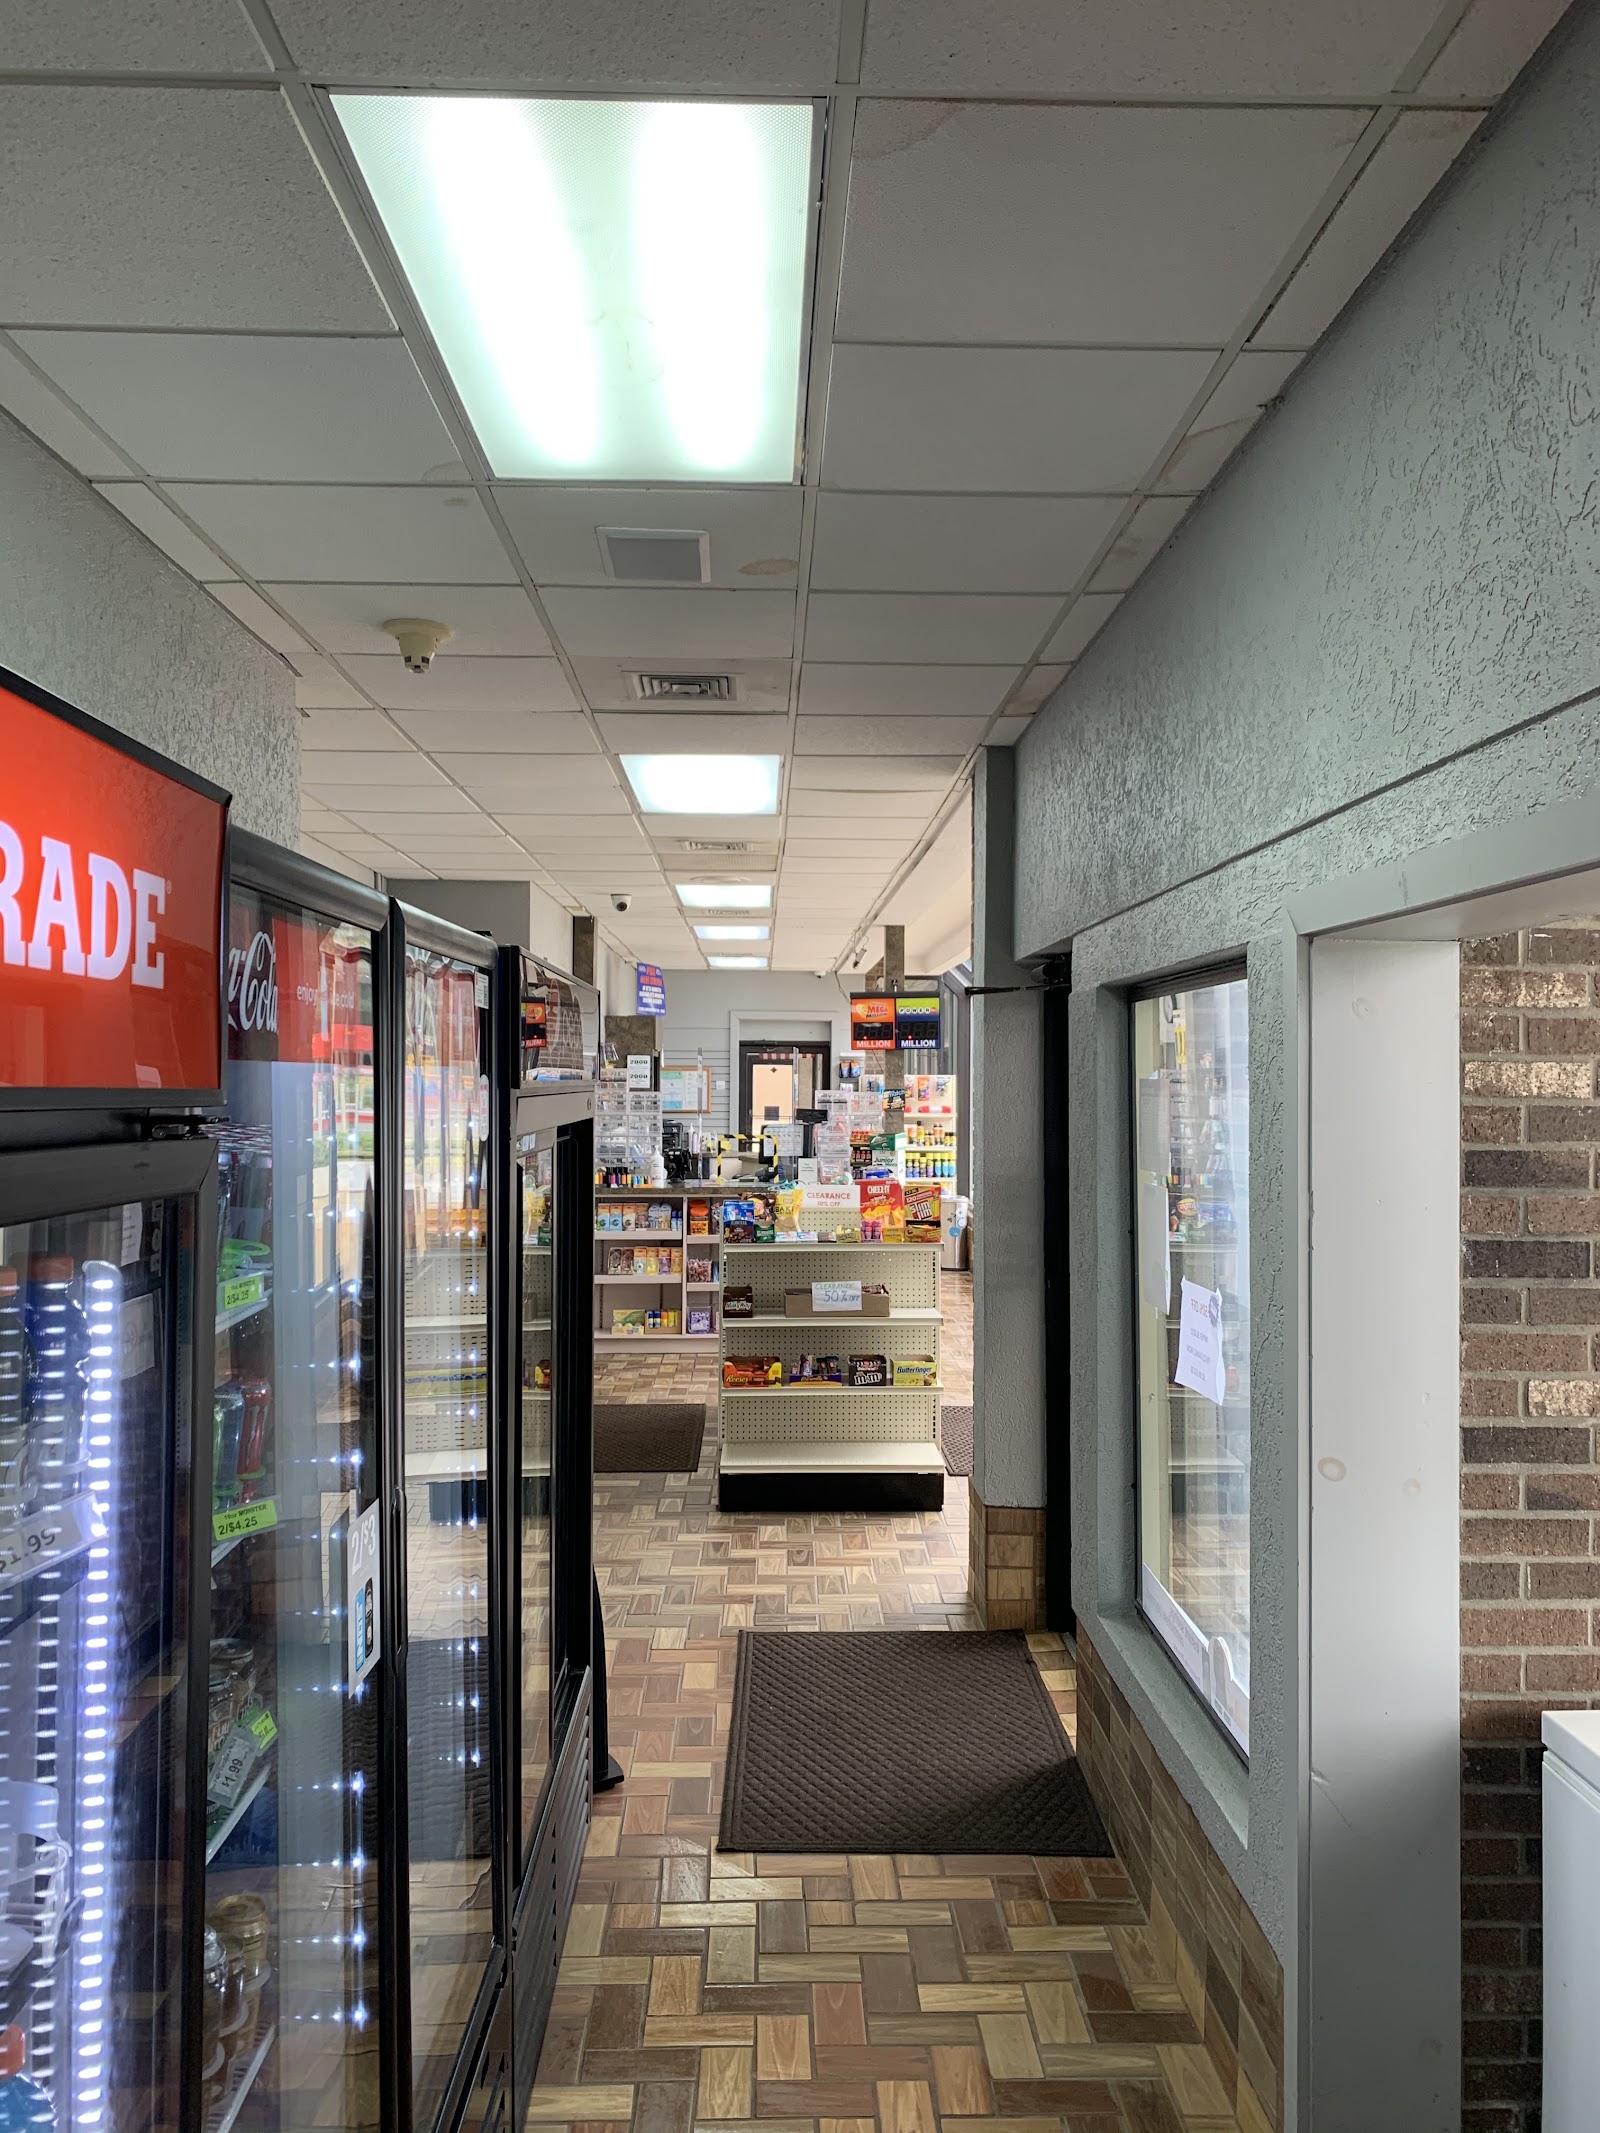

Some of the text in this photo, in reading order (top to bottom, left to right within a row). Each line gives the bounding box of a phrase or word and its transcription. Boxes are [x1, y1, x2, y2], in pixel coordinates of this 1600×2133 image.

[806, 1192, 851, 1200] CLEARANCE
[824, 1290, 848, 1302] 50%
[897, 1366, 932, 1374] Butterfinger
[239, 1504, 267, 1516] MONSTER
[218, 1516, 258, 1535] 2/$4.25
[221, 1758, 243, 1788] $1.99
